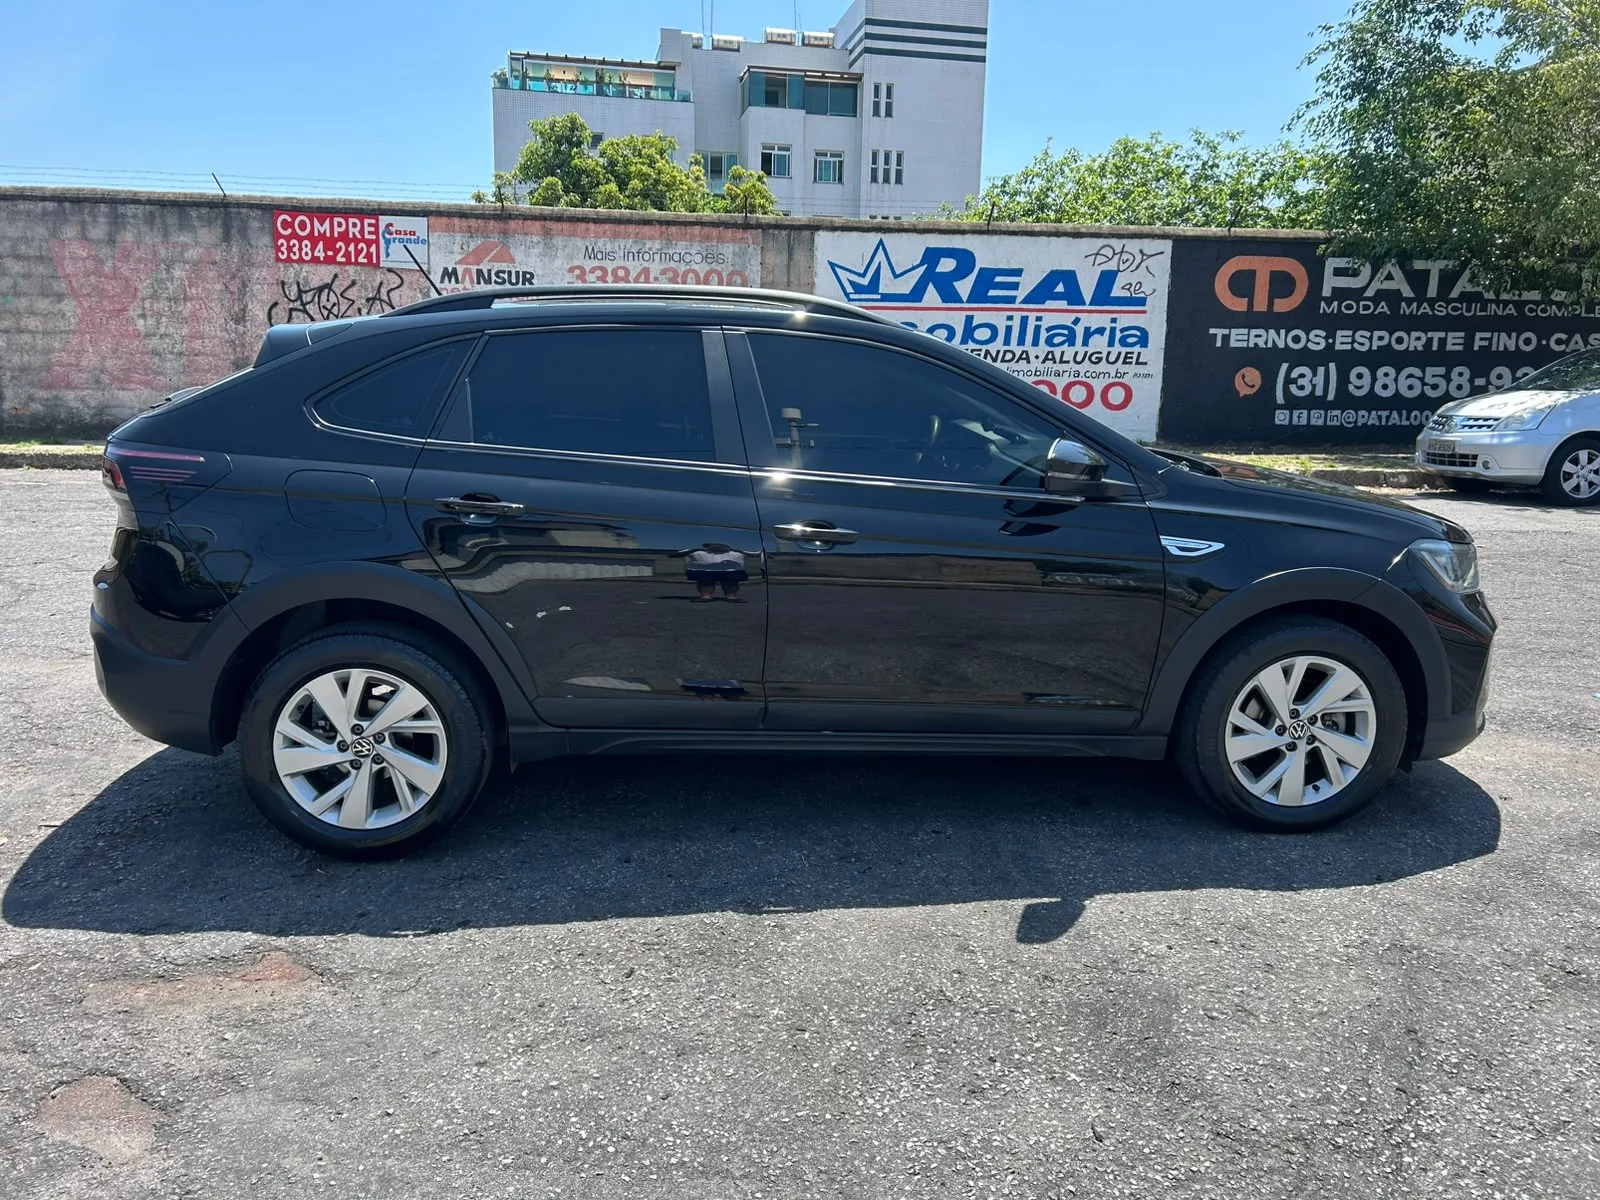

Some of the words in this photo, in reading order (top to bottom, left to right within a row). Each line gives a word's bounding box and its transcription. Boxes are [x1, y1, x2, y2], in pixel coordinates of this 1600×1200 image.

[276, 214, 377, 240] COMPRE
[384, 222, 417, 236] Casa
[277, 239, 377, 264] 3384-2121
[583, 246, 617, 262] Mais
[439, 266, 535, 286] MANSUR
[908, 246, 1148, 307] REAL
[1319, 300, 1391, 316] MODA
[1400, 301, 1517, 318] MASCULINA
[964, 348, 1031, 365] ENDA
[1042, 350, 1149, 366] ALUGUEL
[1275, 362, 1338, 405] (31)
